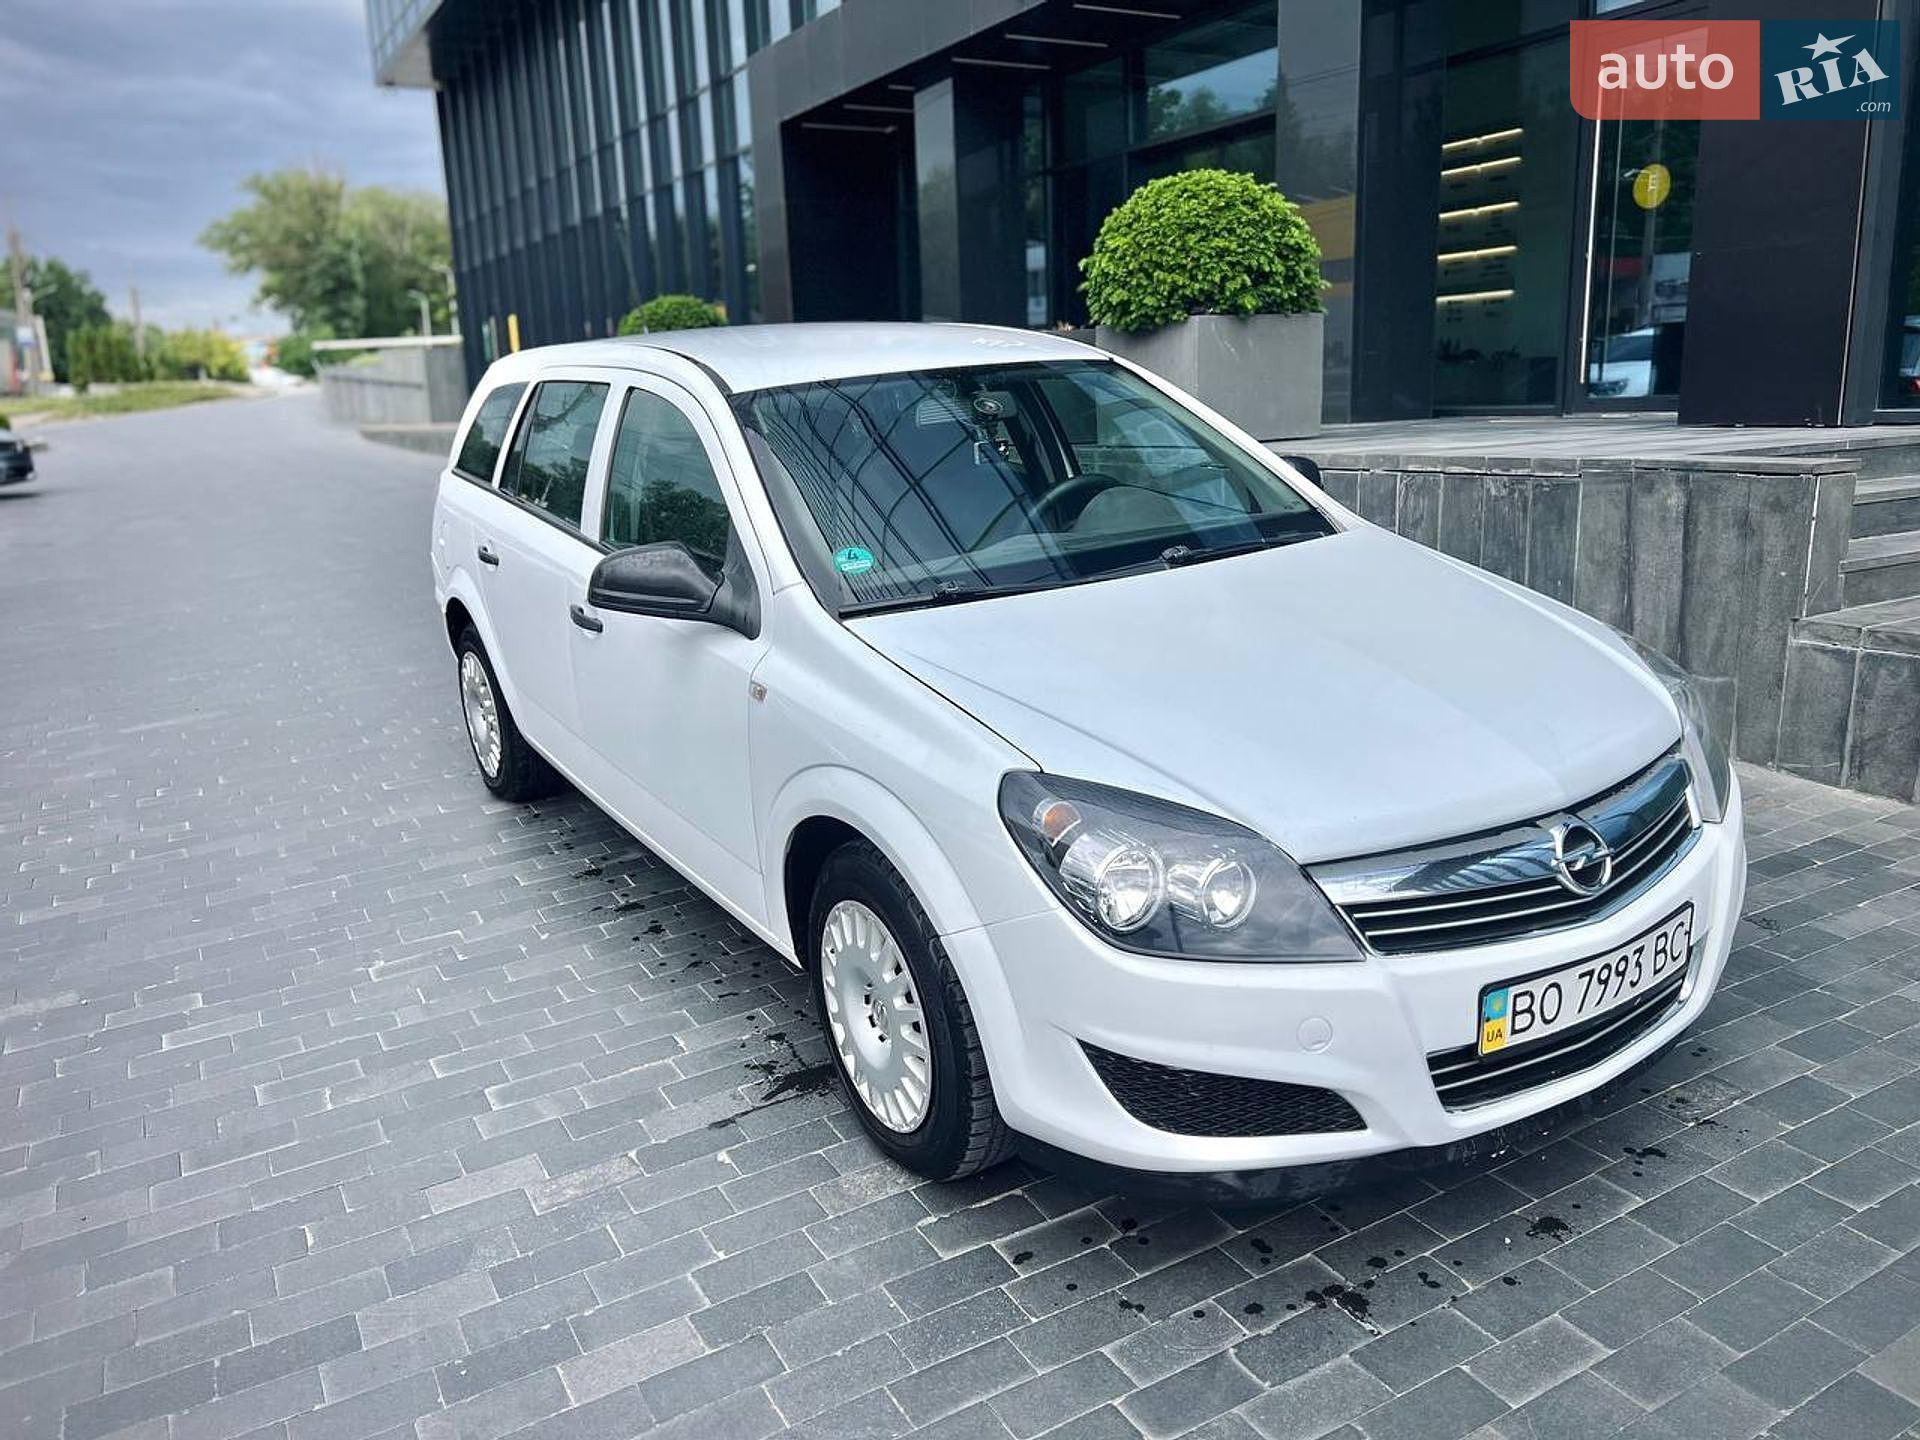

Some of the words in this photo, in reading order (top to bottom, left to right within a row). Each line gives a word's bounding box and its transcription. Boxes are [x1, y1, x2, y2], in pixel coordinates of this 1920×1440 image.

[847, 549, 859, 560] 4
[1510, 981, 1563, 1036] BO
[1576, 944, 1646, 1015] 7993
[1652, 920, 1686, 977] BC
[1485, 1028, 1503, 1043] UA
